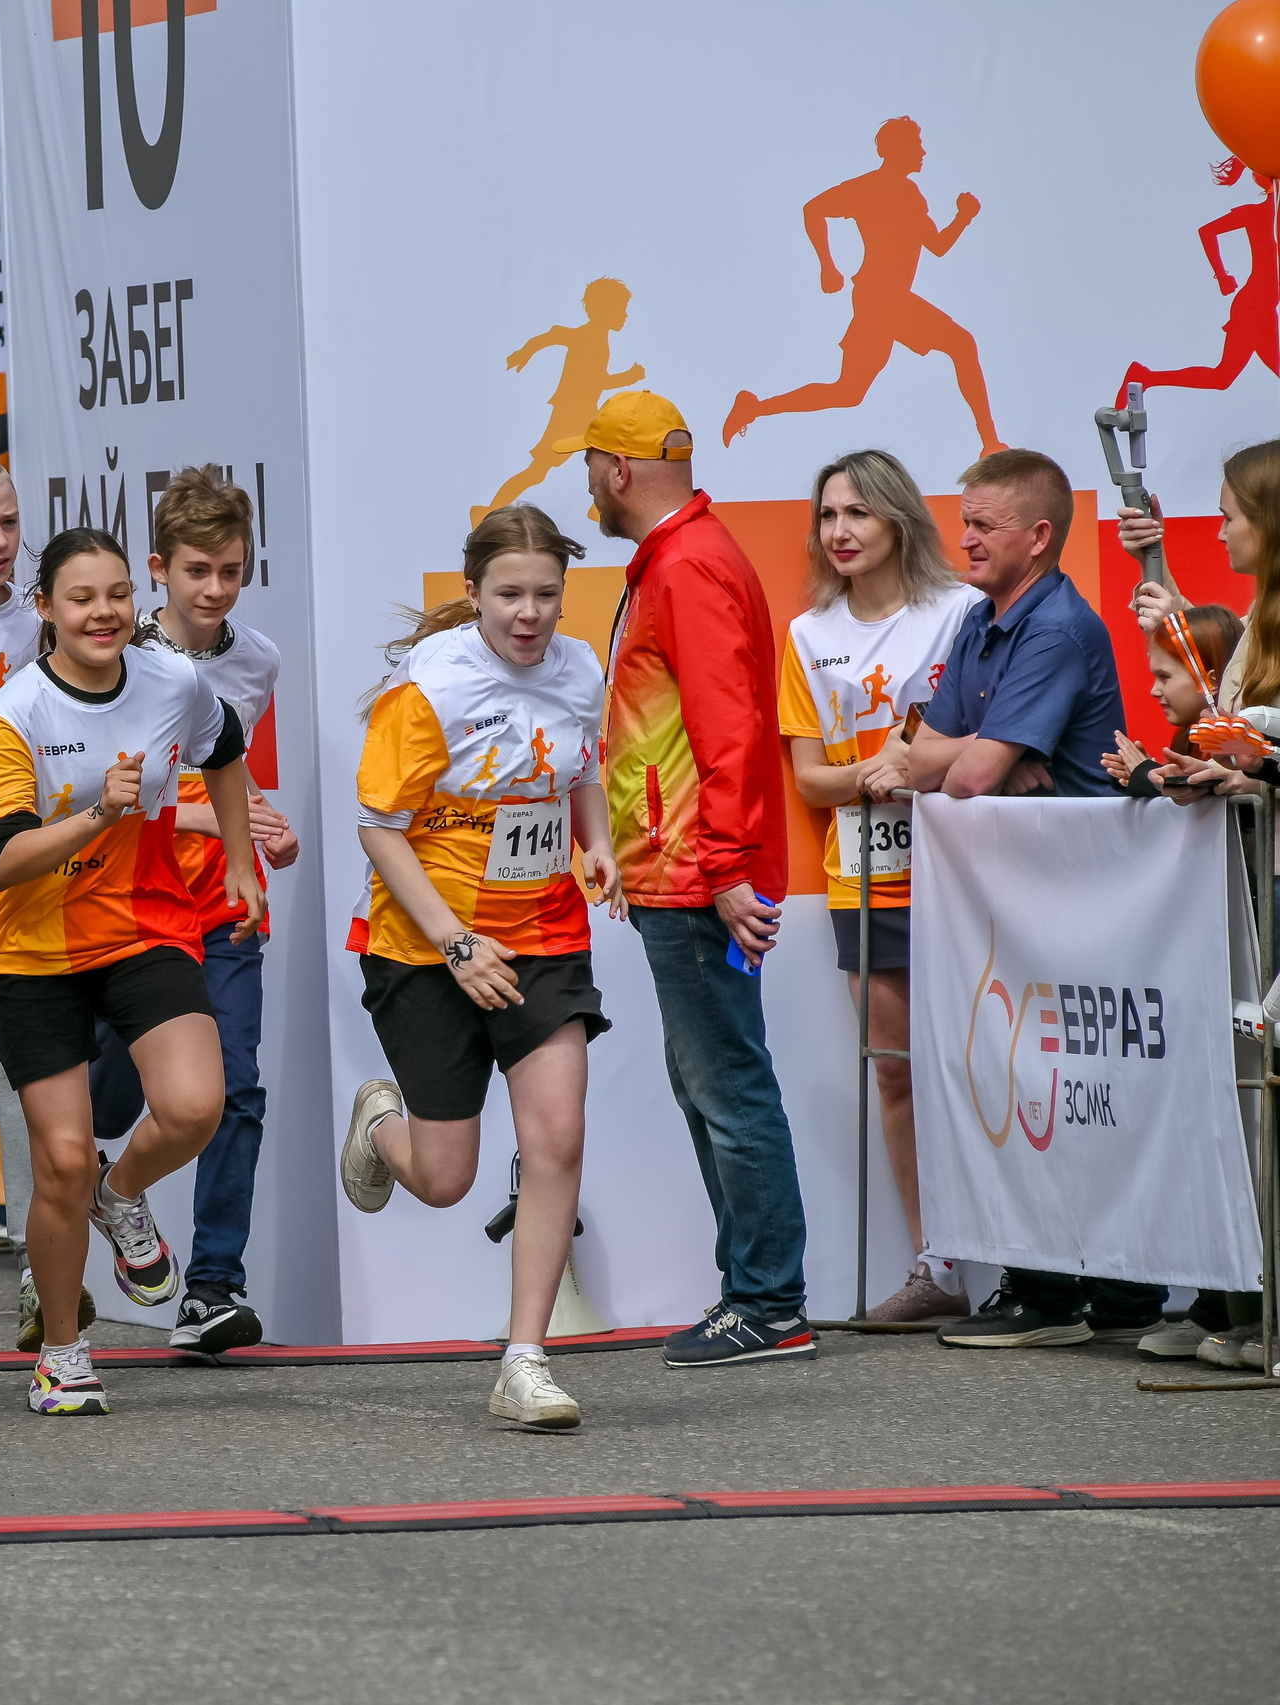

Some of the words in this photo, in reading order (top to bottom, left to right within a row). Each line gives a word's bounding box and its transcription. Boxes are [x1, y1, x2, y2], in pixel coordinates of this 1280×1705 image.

[80, 0, 186, 211] 10
[75, 278, 194, 411] ЗАБЕГ
[815, 655, 851, 669] ЕВРАЗ
[44, 742, 86, 756] ЕВРАЗ
[506, 817, 563, 857] 1141
[497, 866, 511, 879] 10
[510, 871, 526, 879] ДАЙ
[527, 870, 543, 878] ПЯТЬ
[849, 862, 861, 874] 10
[1058, 984, 1167, 1060] ЕВРАЗ
[1028, 1100, 1043, 1121] ЛЕТ
[1064, 1079, 1117, 1127] ЗСМК
